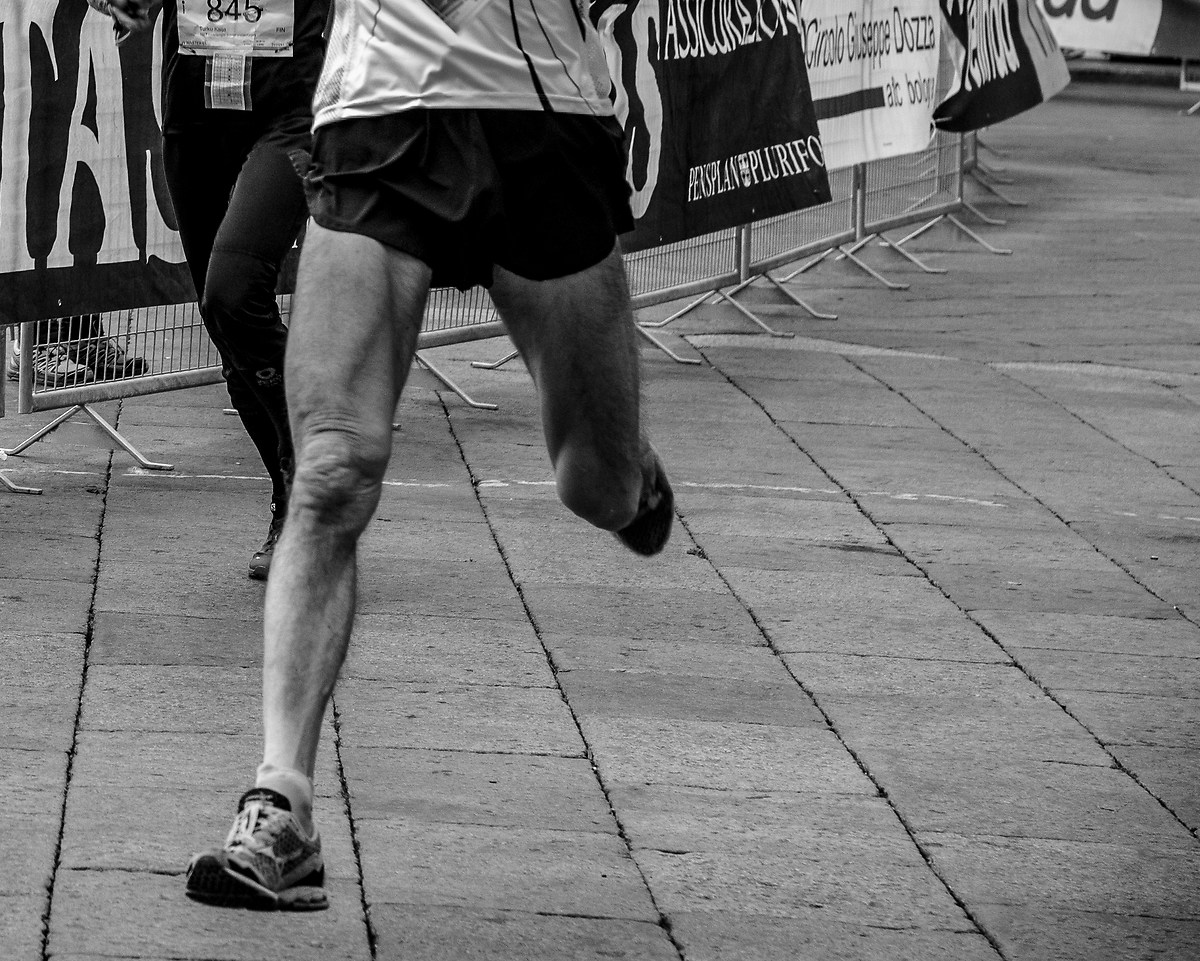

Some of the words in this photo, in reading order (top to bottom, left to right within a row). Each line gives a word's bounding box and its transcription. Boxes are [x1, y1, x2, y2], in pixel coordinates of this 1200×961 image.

[846, 11, 891, 70] Giuseppe
[893, 6, 936, 54] Dozza
[688, 155, 740, 202] PENSPLAN
